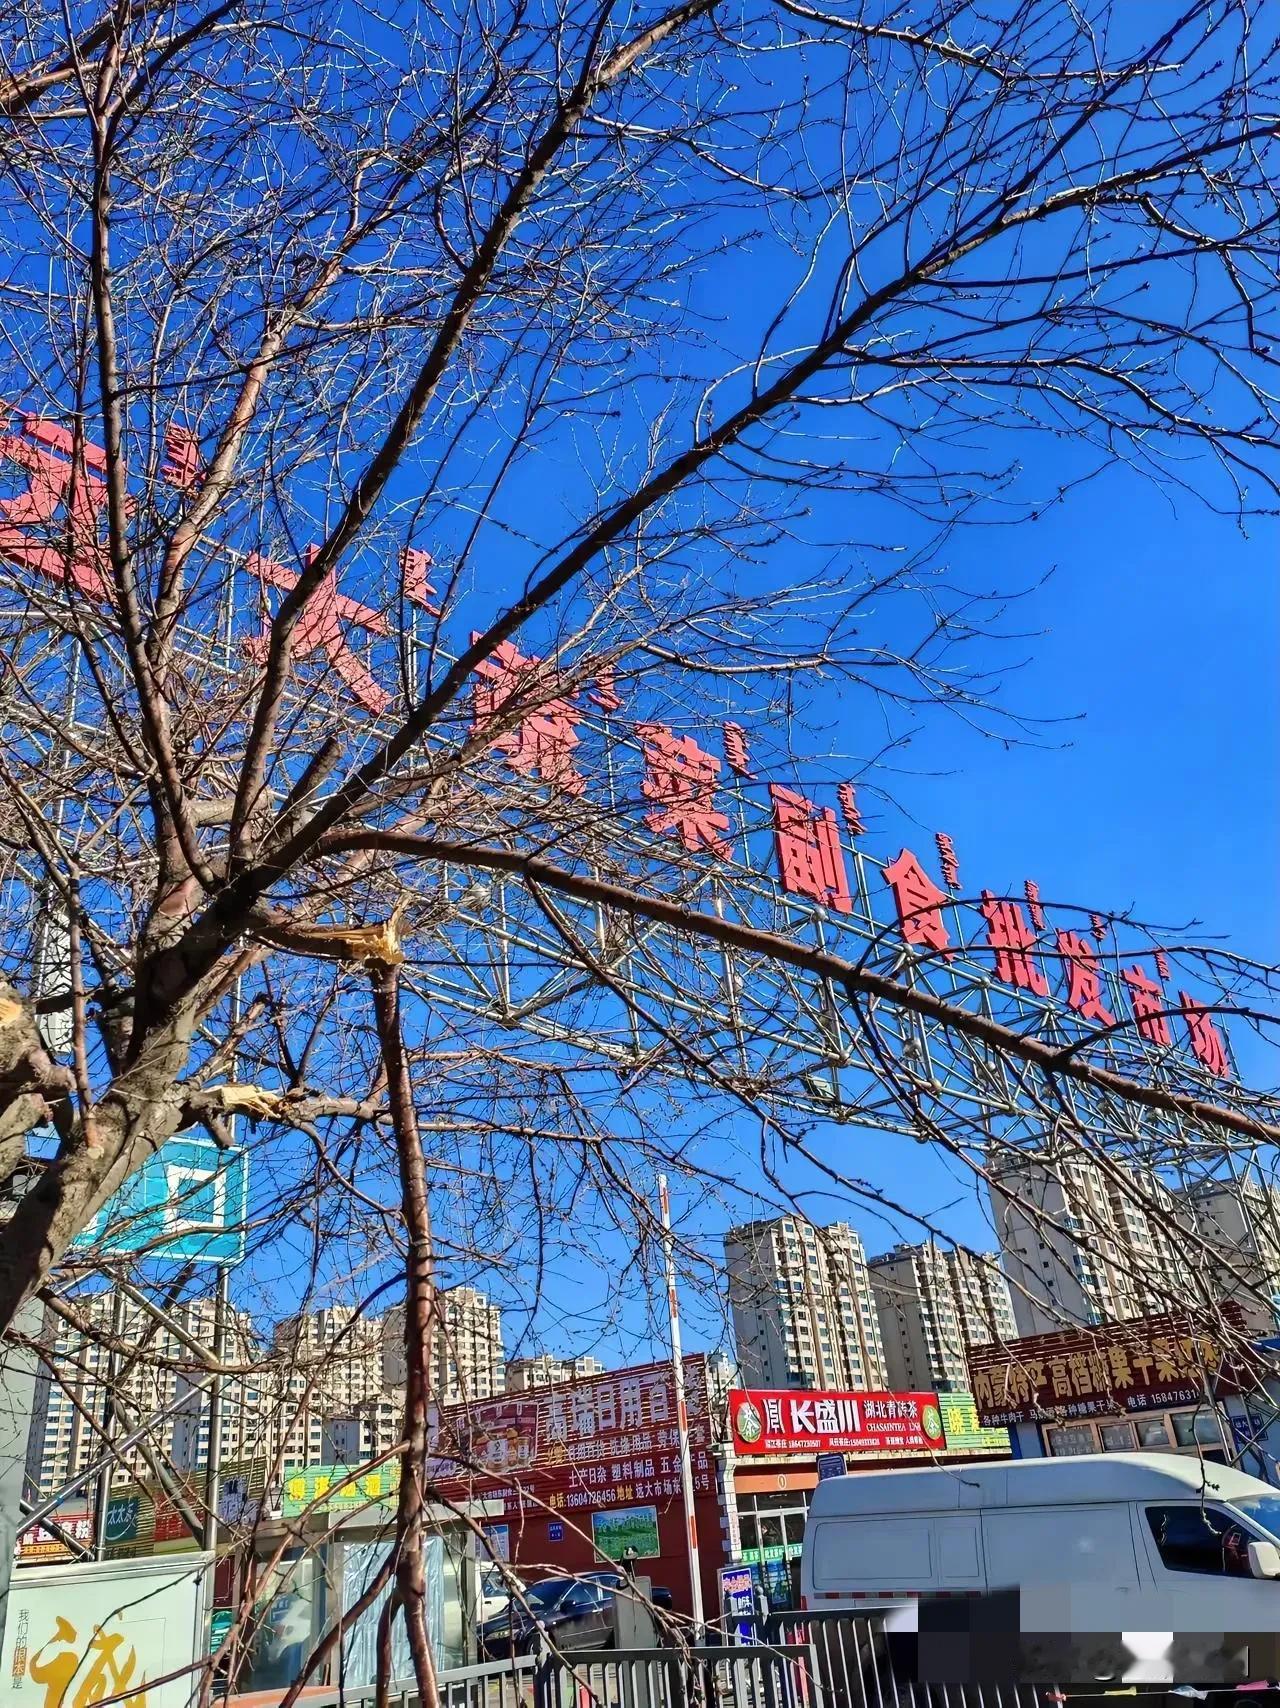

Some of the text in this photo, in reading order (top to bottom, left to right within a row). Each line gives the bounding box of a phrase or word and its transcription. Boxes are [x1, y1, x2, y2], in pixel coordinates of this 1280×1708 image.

[1127, 1391, 1200, 1407] 电话 15847631
[790, 1399, 860, 1434] 长盛川
[569, 1465, 607, 1488] 土产日杂
[612, 1458, 655, 1482] 塑料制品
[12, 1608, 29, 1690] 我们的根本是
